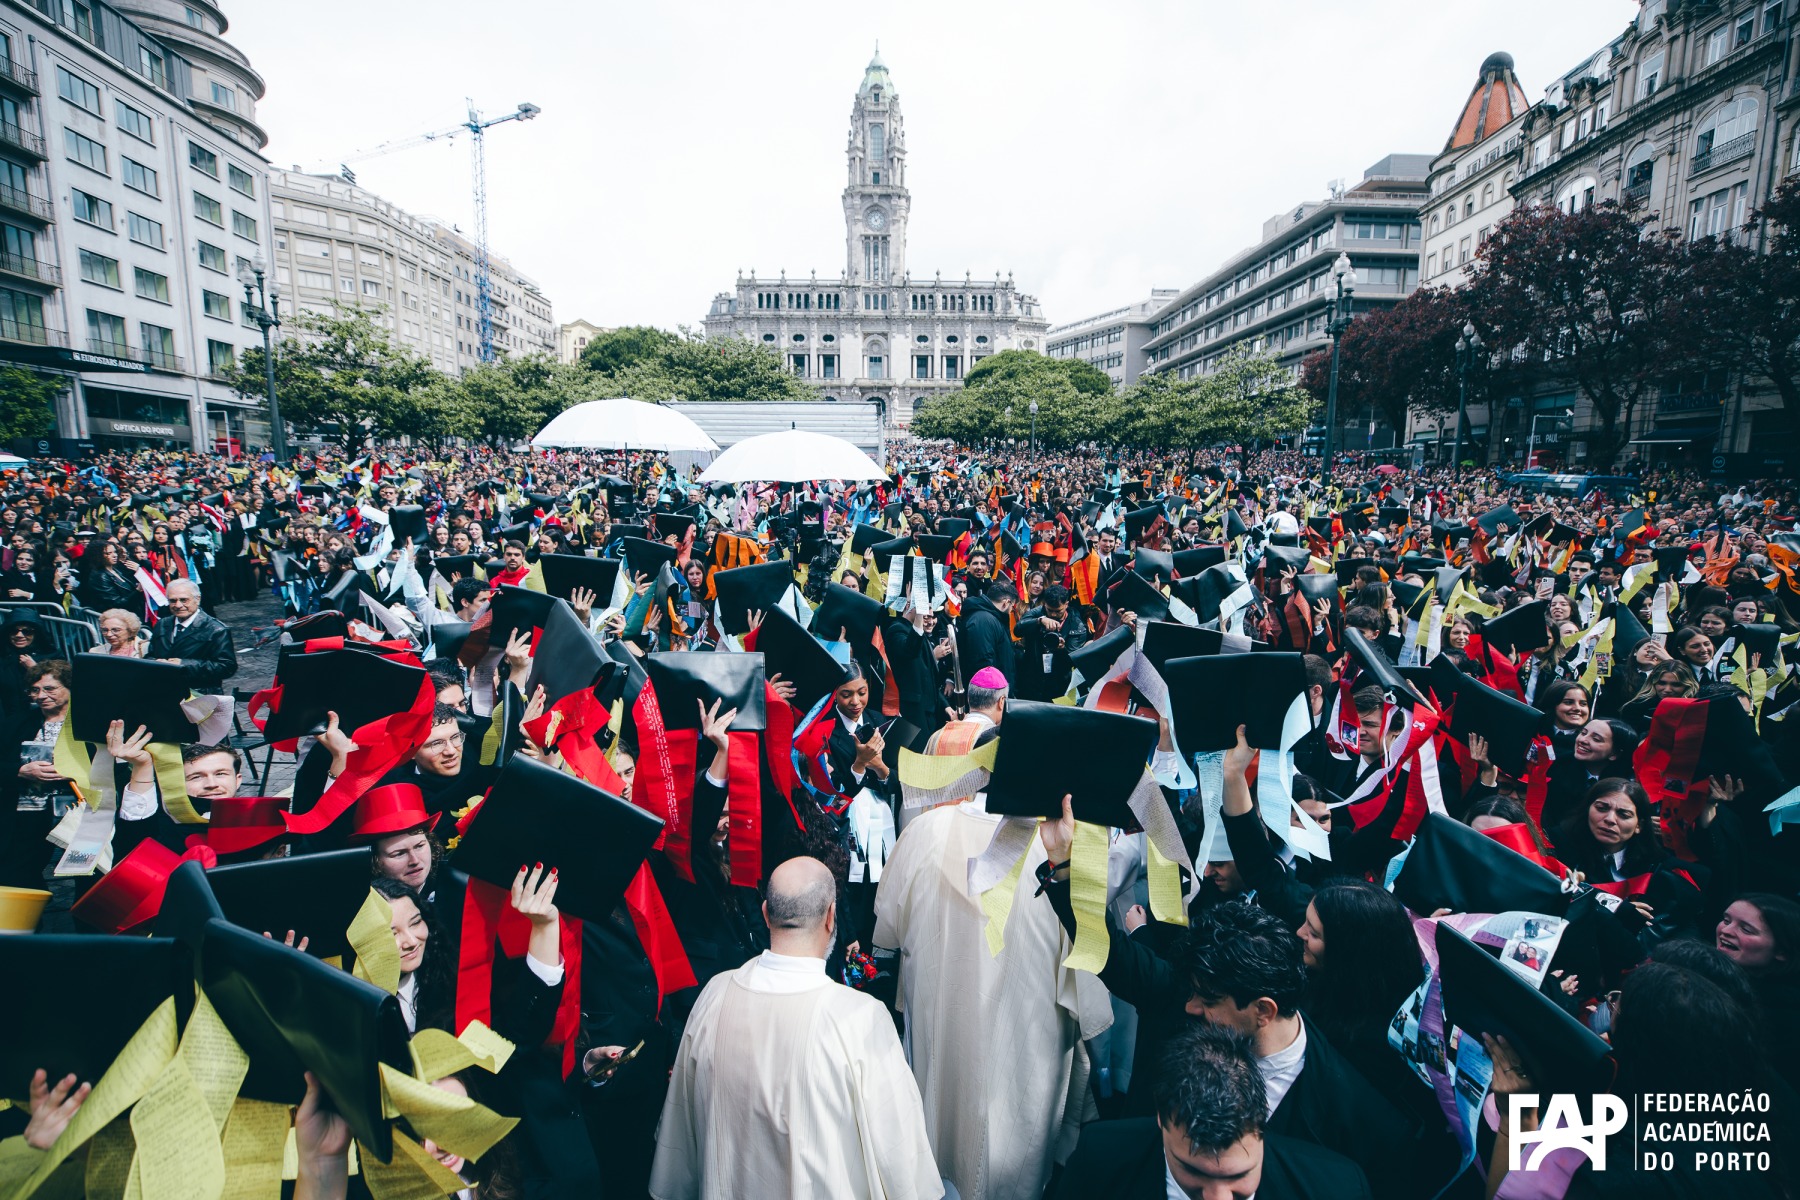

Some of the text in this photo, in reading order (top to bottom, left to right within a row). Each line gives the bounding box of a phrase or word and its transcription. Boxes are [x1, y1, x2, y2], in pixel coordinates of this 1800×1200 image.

[80, 353, 145, 371] EUROSTARS ALIADOS
[141, 425, 152, 434] DO
[152, 427, 174, 436] PORTO
